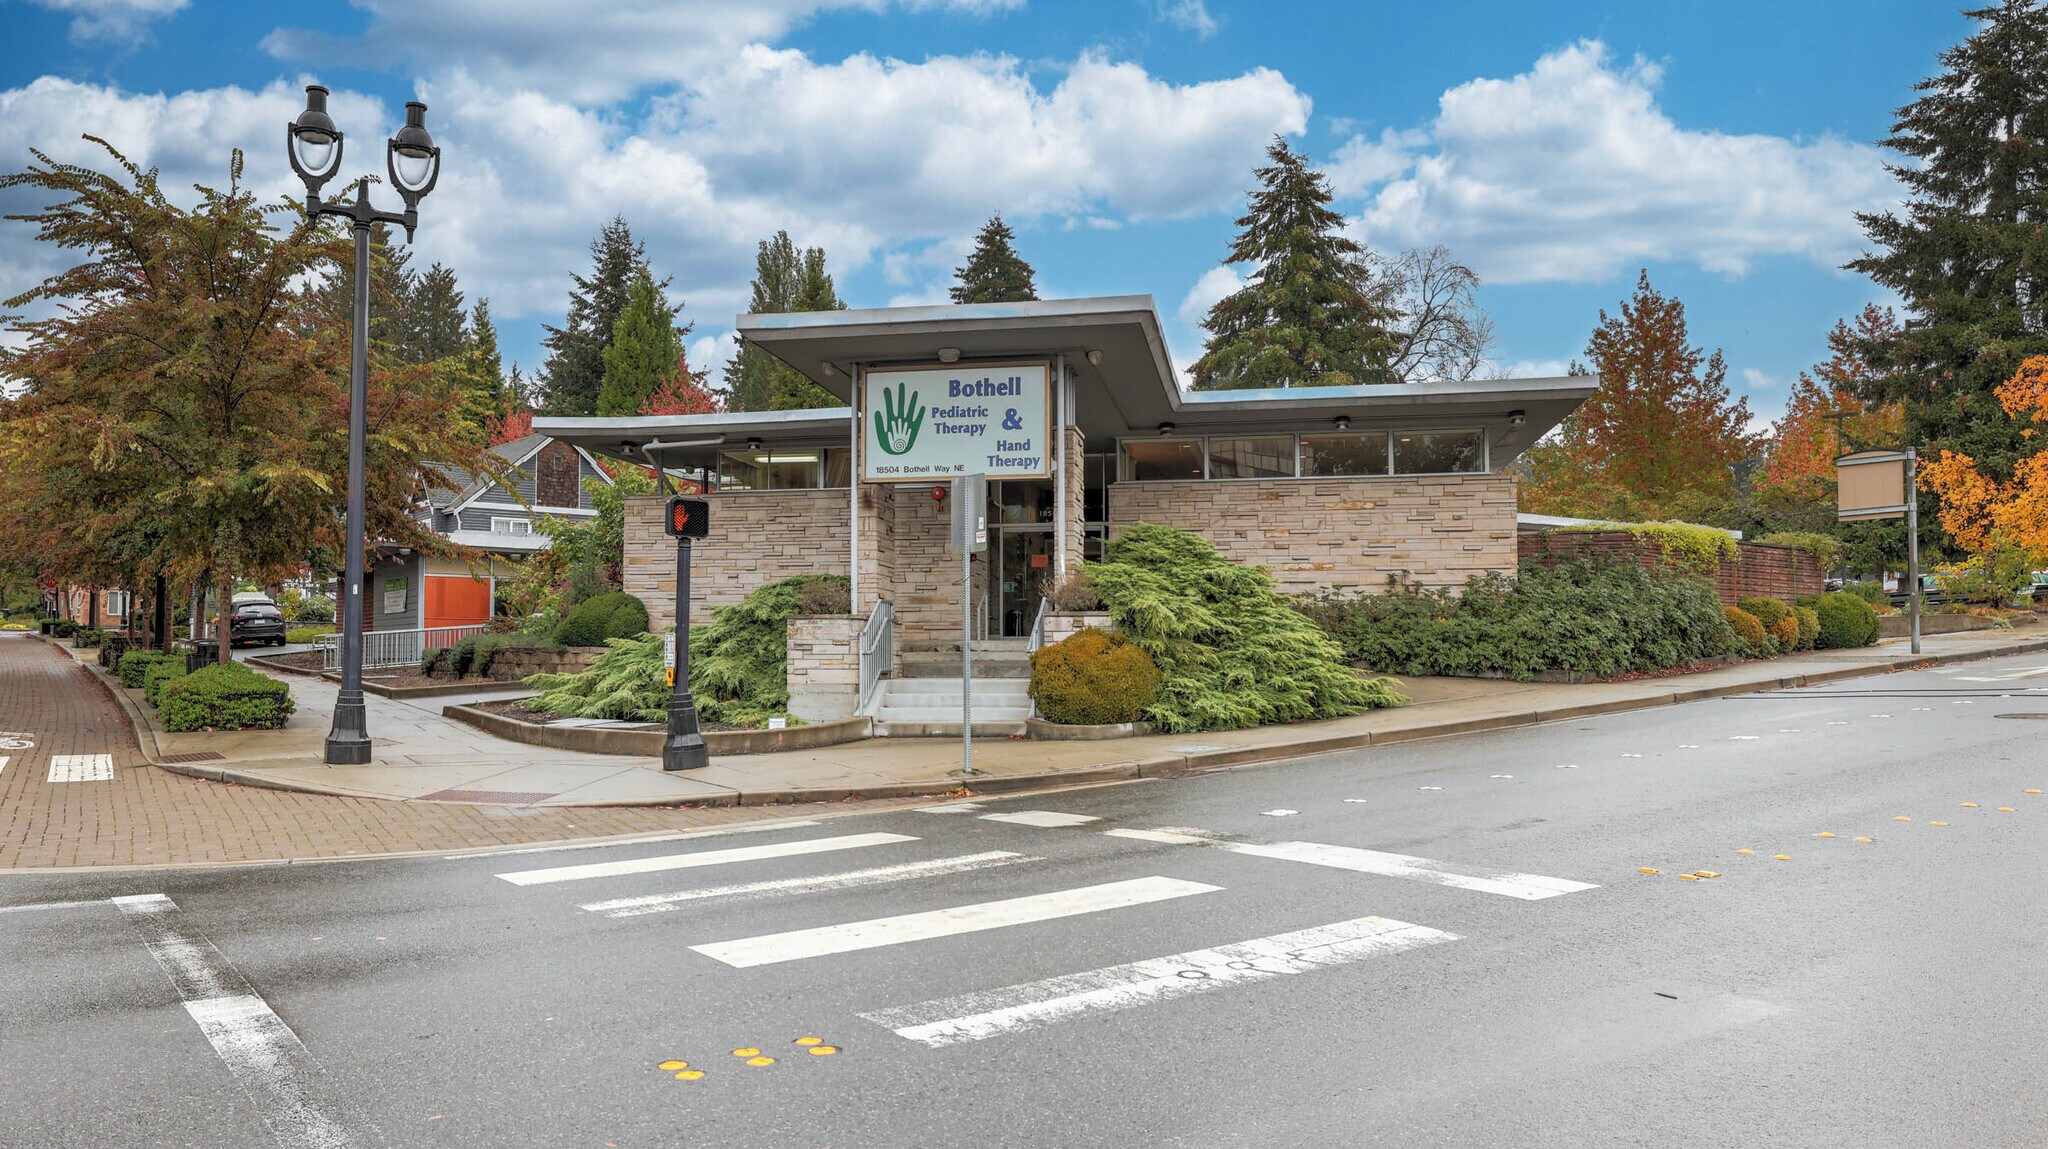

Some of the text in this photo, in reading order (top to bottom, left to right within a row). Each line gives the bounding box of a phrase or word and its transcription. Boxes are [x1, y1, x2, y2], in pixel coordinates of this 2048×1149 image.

[949, 377, 1021, 397] Bothell
[931, 405, 988, 418] Pediatric
[1002, 408, 1023, 430] &
[934, 422, 986, 436] Therapy
[996, 439, 1031, 451] Hand
[876, 464, 965, 474] 18504 Bothell Way NE
[987, 455, 1040, 469] Therapy
